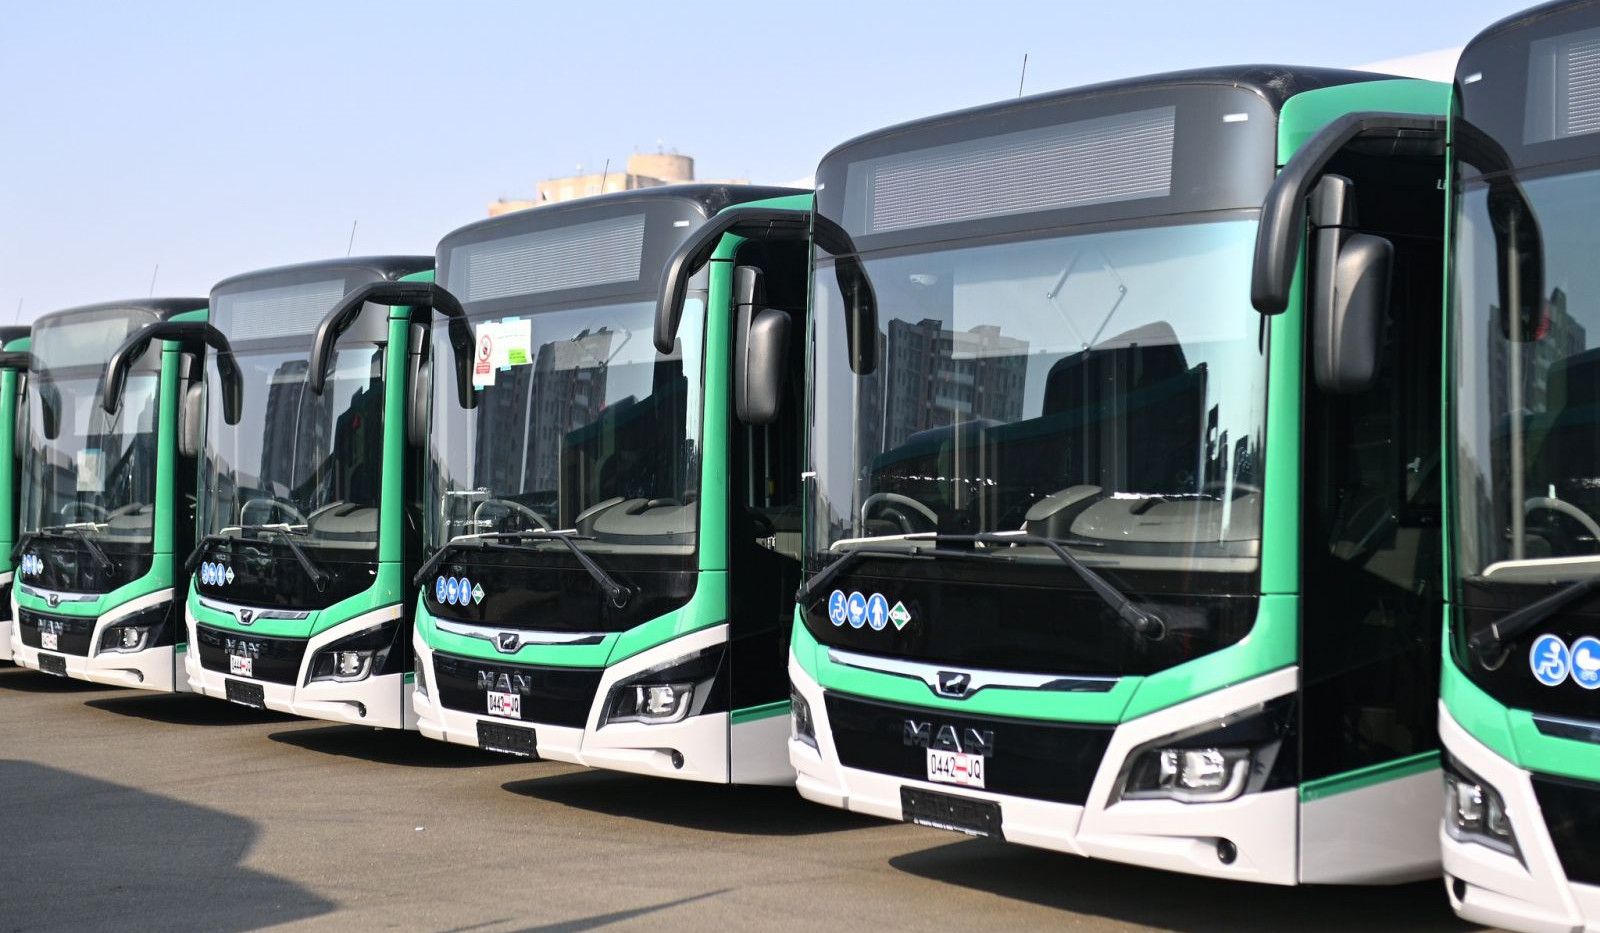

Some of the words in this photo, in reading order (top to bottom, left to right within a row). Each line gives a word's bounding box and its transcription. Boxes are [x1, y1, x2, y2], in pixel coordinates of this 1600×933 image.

[224, 638, 261, 659] MAN
[477, 670, 532, 695] MAN
[903, 720, 993, 756] MAN
